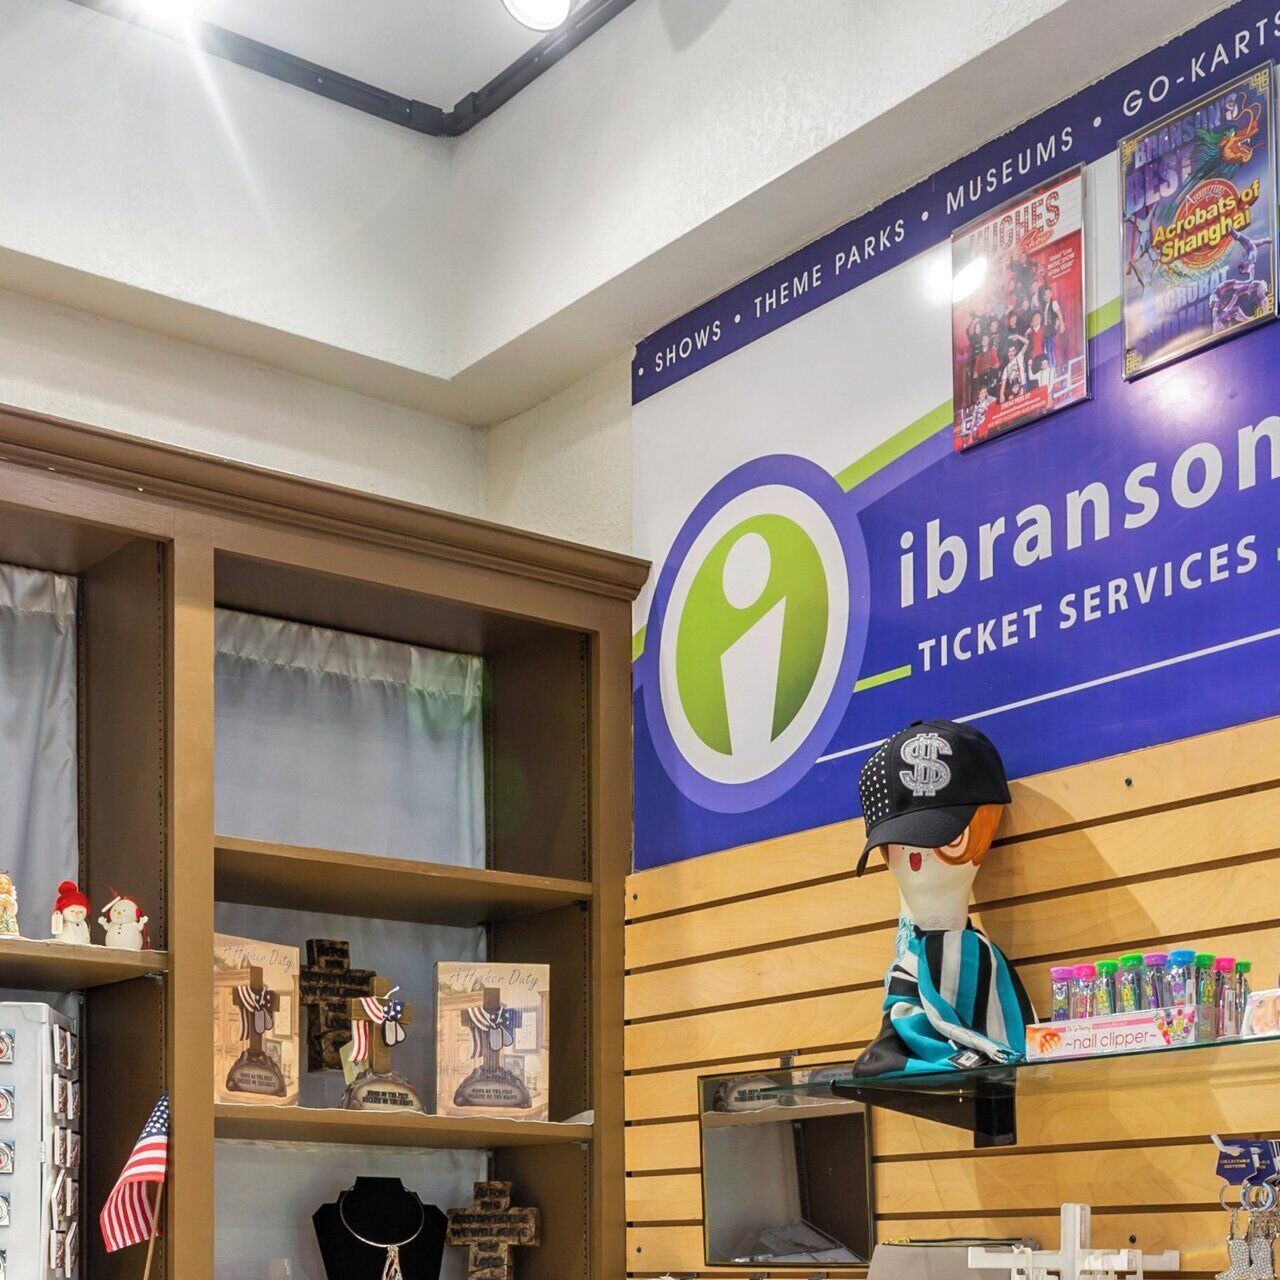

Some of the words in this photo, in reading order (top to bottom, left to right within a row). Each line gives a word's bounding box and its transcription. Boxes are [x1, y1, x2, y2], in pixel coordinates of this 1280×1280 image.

[1153, 195, 1236, 246] Acrobats
[1241, 178, 1260, 203] of
[1161, 205, 1251, 263] Shanghai
[655, 320, 721, 372] SHOWS
[754, 264, 822, 318] THEME
[835, 219, 905, 275] PARKS
[945, 126, 1074, 214] MUSEUMS
[918, 604, 1042, 672] TICKET
[1059, 535, 1258, 629] SERVICES
[270, 950, 294, 975] Duty
[508, 969, 541, 990] Duty
